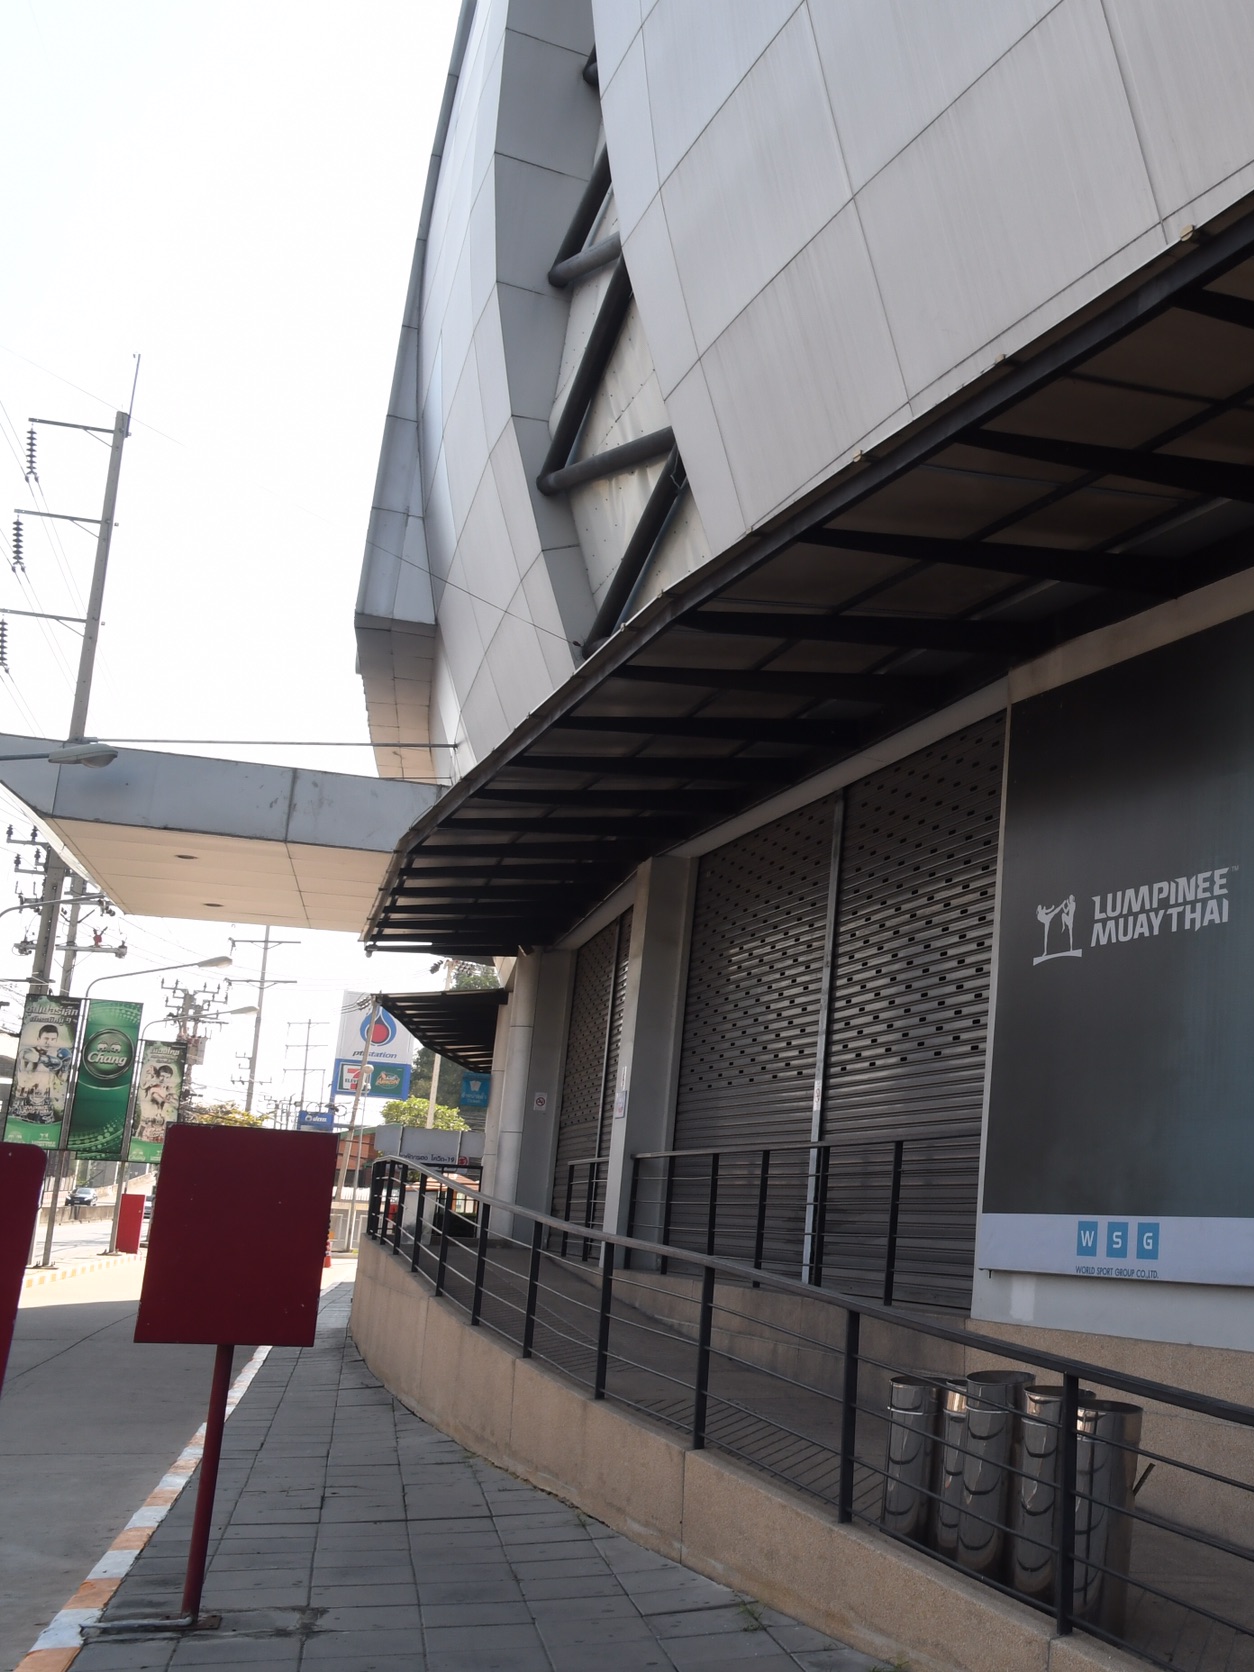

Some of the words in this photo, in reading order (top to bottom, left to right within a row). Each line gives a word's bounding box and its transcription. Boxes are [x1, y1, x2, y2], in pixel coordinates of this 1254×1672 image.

[1091, 867, 1230, 920] LUMPINEE
[1090, 909, 1165, 947] MUAY
[1166, 897, 1229, 932] THAI
[87, 1051, 128, 1067] Chang
[1075, 1265, 1096, 1275] WORLD
[1096, 1267, 1114, 1276] SPORT
[1115, 1268, 1135, 1277] GROUP
